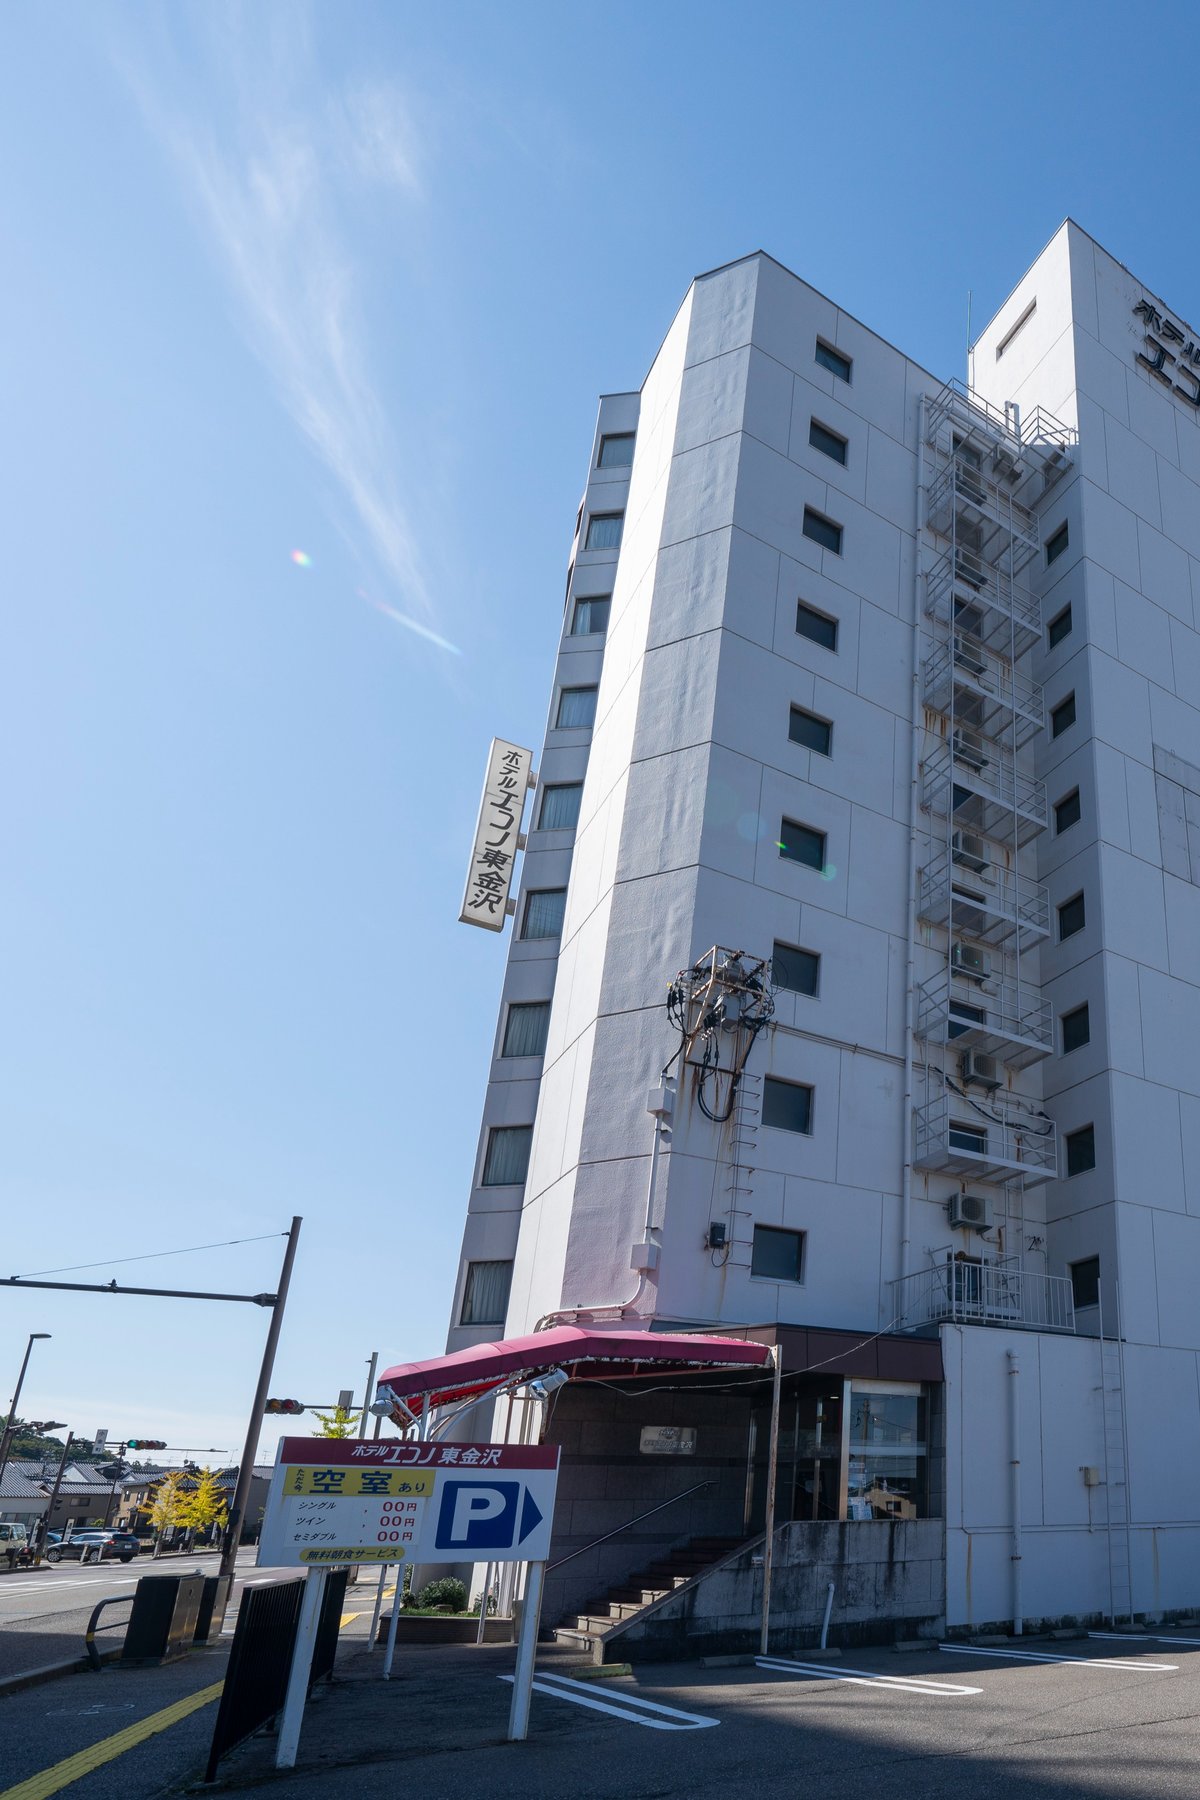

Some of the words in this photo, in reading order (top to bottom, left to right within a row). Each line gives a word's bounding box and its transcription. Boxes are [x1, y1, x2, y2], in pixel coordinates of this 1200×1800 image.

[294, 1468, 305, 1493] ただ今
[298, 1501, 337, 1511] シングル
[450, 1487, 507, 1542] P
[295, 1517, 326, 1526] ツイン
[293, 1532, 337, 1542] セミダブル
[305, 1548, 399, 1561] 無料朝食サービス
